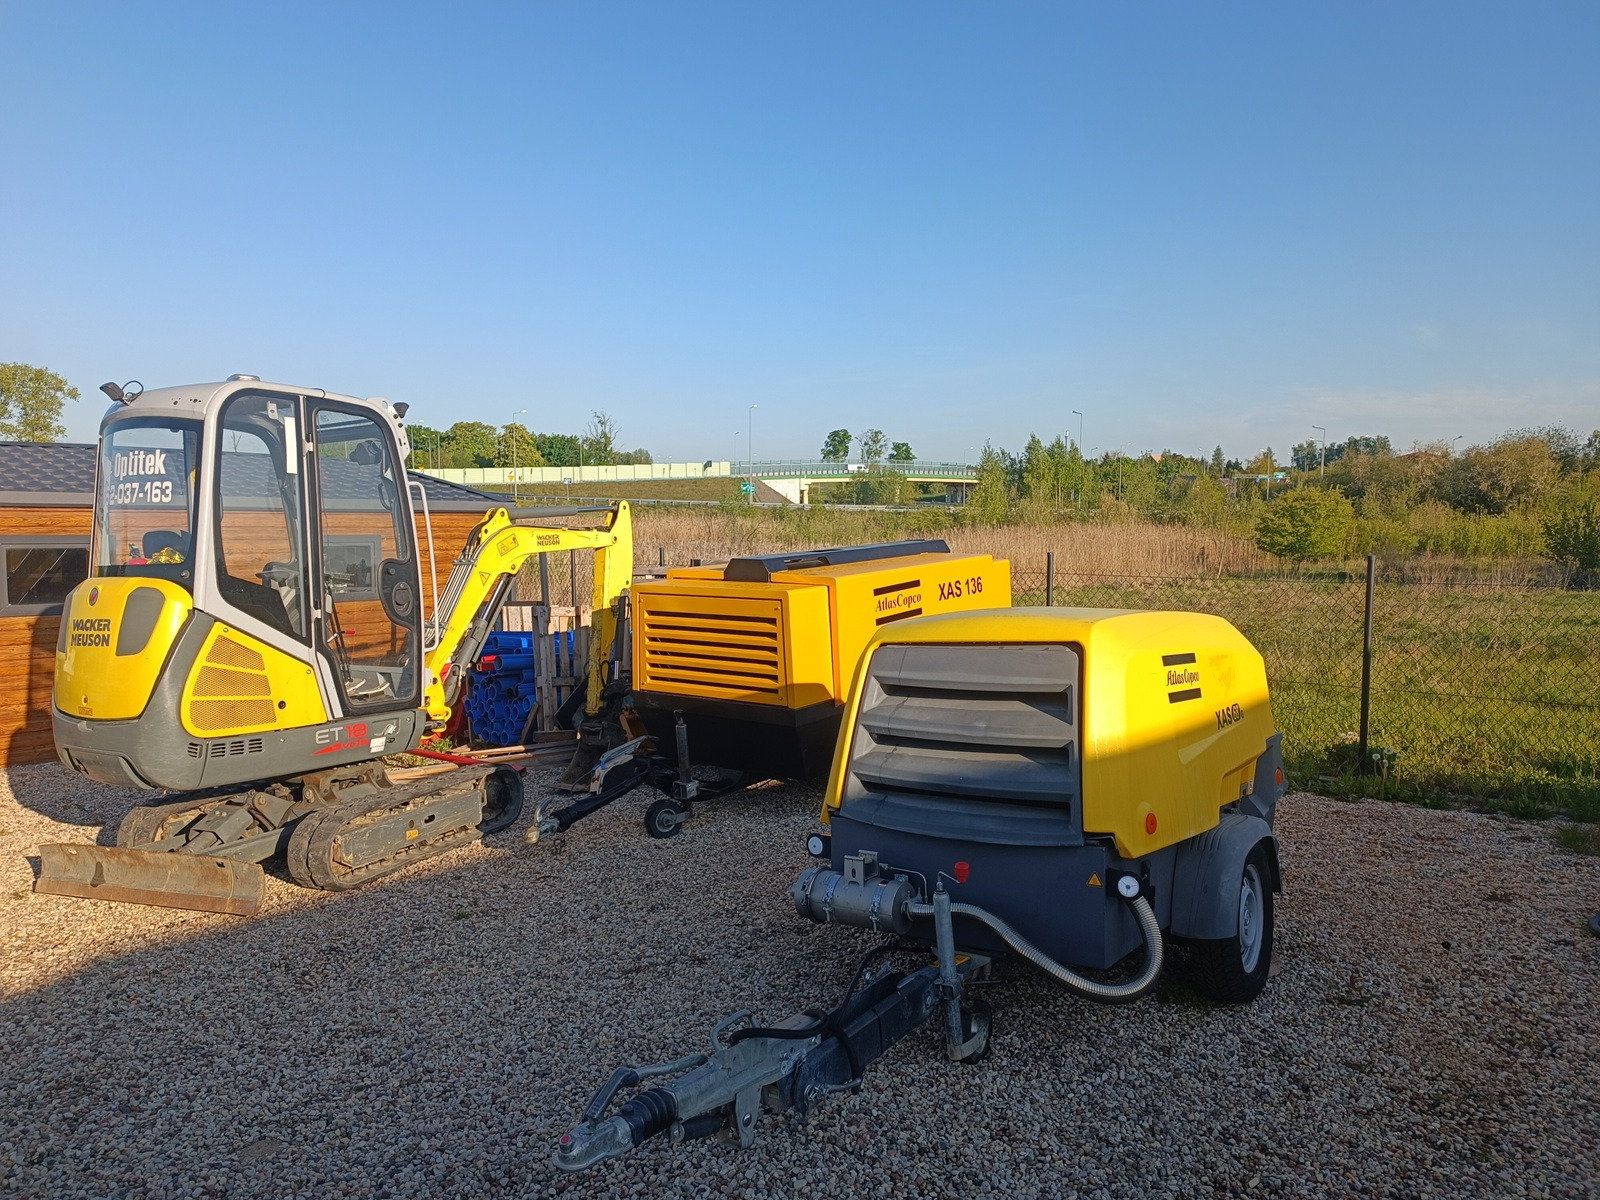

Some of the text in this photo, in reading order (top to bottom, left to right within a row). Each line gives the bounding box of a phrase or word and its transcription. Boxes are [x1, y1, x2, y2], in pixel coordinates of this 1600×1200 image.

[114, 449, 167, 481] Optitek
[537, 539, 560, 547] NEUSON
[938, 576, 983, 602] XAS 136
[72, 618, 111, 631] WACKER
[70, 634, 110, 647] NEUSON
